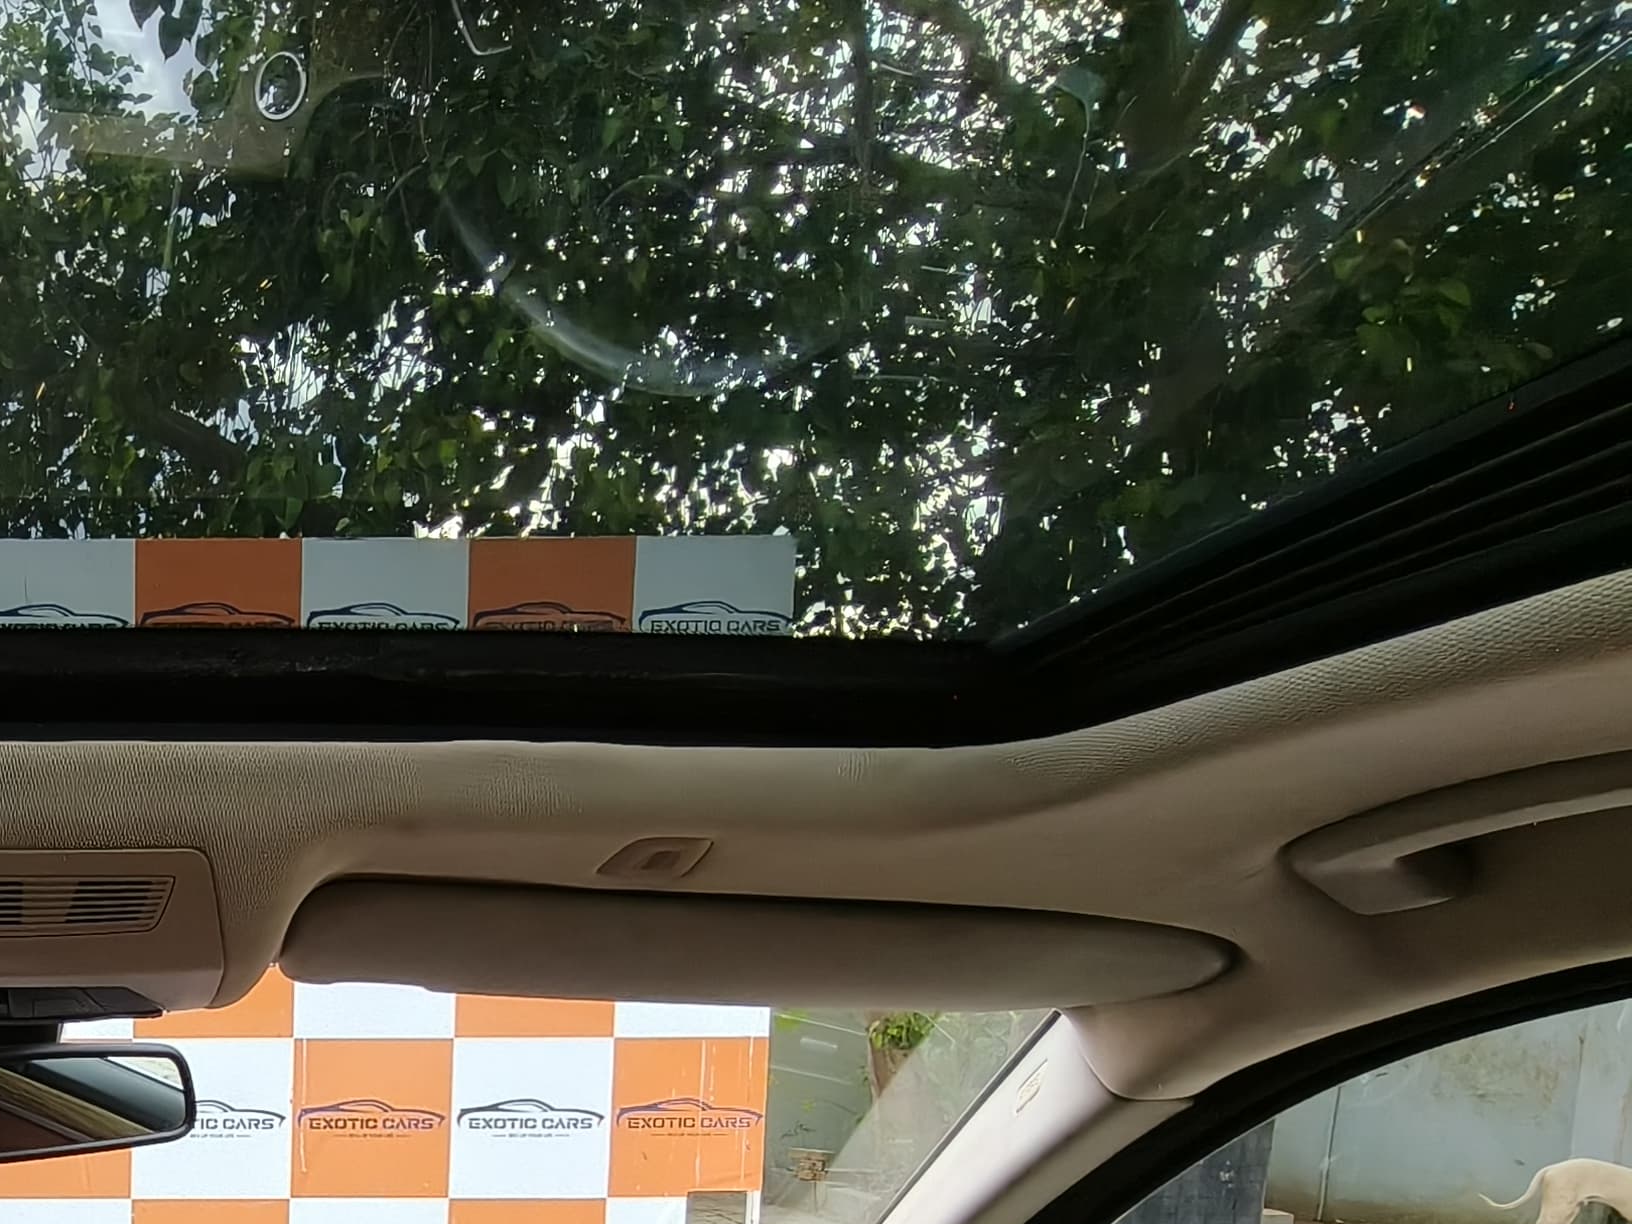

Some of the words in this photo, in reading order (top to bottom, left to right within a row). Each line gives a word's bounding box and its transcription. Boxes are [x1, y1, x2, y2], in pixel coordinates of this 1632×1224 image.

[223, 1118, 274, 1130] CARS
[308, 1118, 378, 1130] EXOTIC
[382, 1118, 434, 1130] CARS
[468, 1118, 537, 1130] EXOTIC
[542, 1118, 593, 1130] CARS
[627, 1117, 696, 1129] EXOTIC
[700, 1117, 751, 1128] CARS
